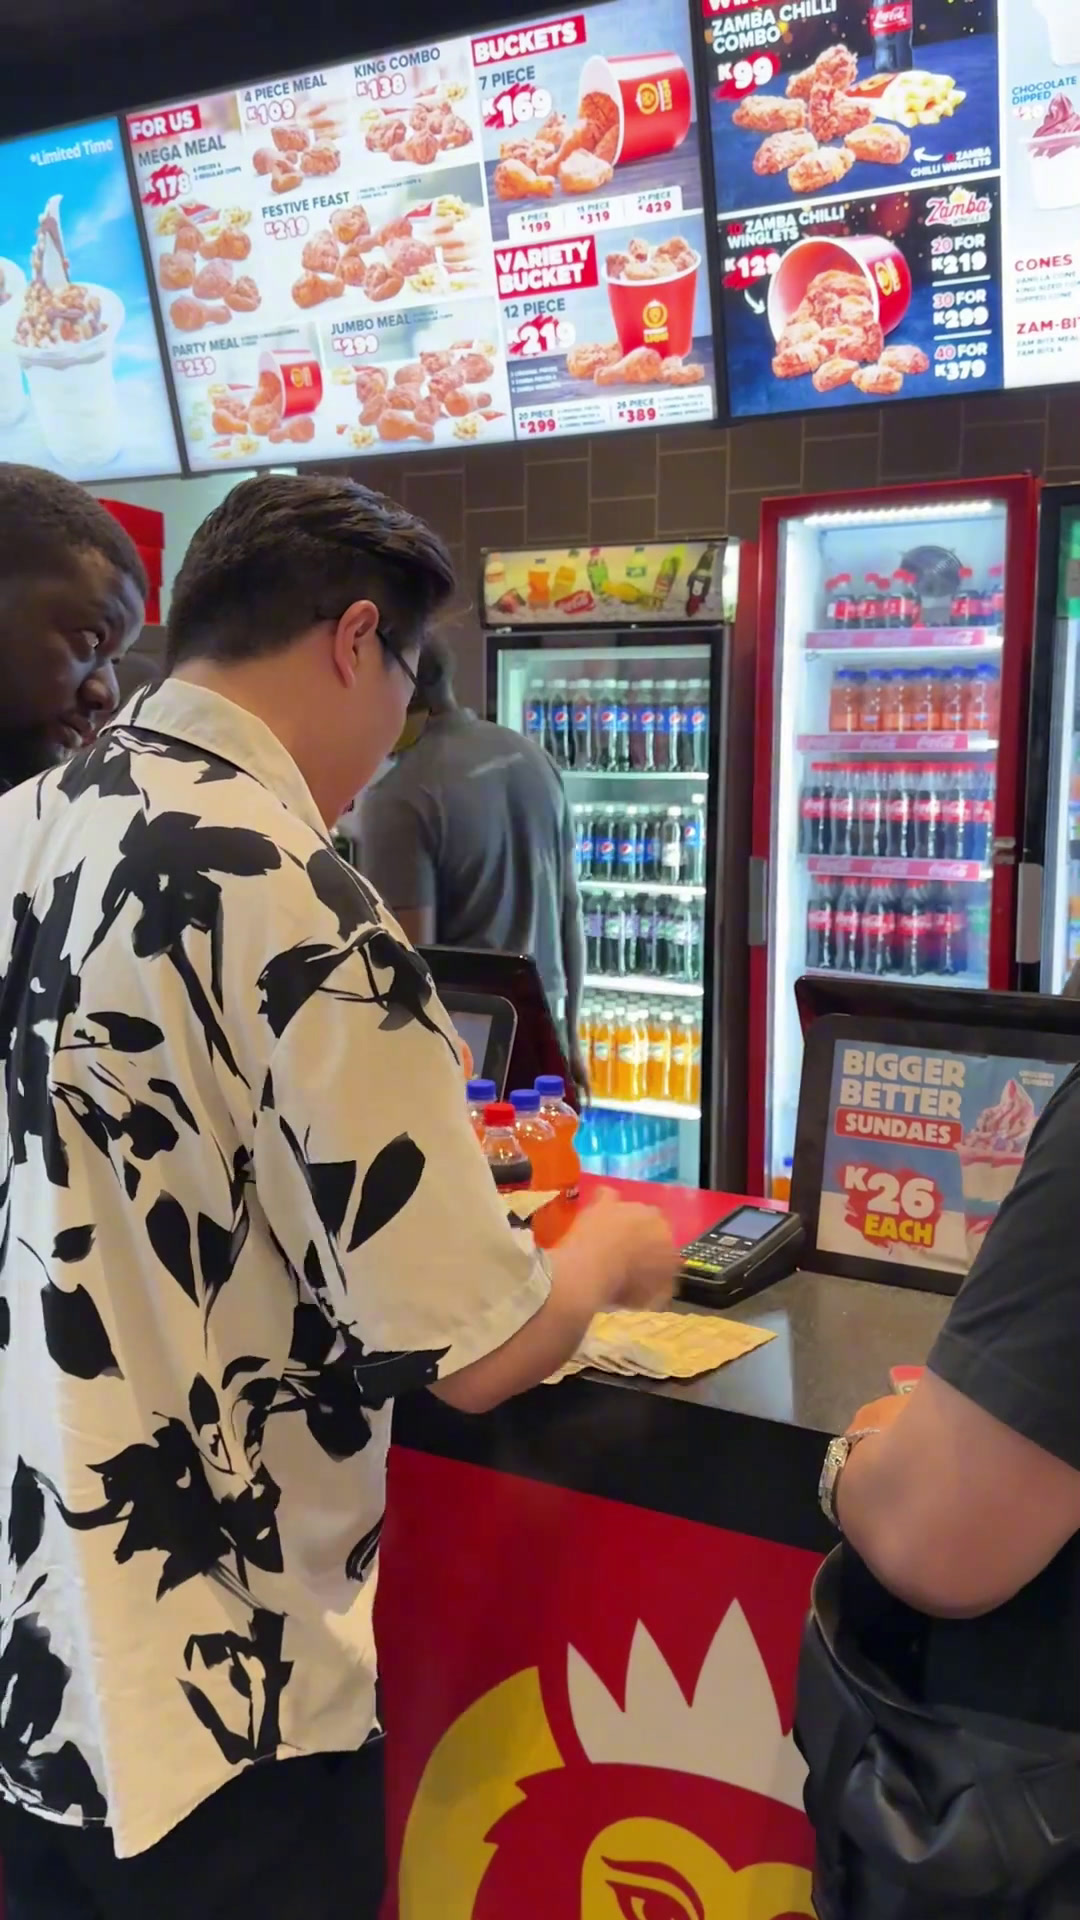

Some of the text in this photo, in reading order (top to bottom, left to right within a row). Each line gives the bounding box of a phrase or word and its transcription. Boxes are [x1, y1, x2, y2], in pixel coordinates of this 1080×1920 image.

[712, 9, 776, 37] ZAMBA
[780, 0, 836, 21] CHILLI
[474, 21, 577, 64] BUCKETS
[713, 25, 781, 54] COMBO
[354, 47, 440, 78] KING COMBO
[717, 57, 773, 89] K99
[244, 74, 327, 102] 4 PIECE MEAL
[356, 74, 406, 100] K138
[479, 65, 536, 90] 7 PIECE
[1012, 75, 1077, 96] CHOCOLATE
[481, 88, 552, 126] K169
[1012, 90, 1052, 105] DIPPED
[247, 99, 297, 125] K109
[130, 110, 195, 140] FOR US
[82, 139, 113, 155] Time
[139, 135, 226, 167] MEGA MEAL
[956, 146, 992, 160] ZAMBA
[911, 163, 941, 177] CHILLI
[262, 199, 310, 219] FESTIVE
[312, 191, 350, 210] FEAST
[588, 201, 610, 211] PIECE
[648, 190, 671, 200] PIECE
[528, 212, 549, 221] PIECE
[927, 191, 988, 224] Zamba
[264, 216, 308, 240] K219
[745, 214, 797, 234] ZAMBA
[799, 206, 845, 225] CHILLI
[727, 227, 799, 249] WINGLETS
[931, 234, 985, 254] 20 FOR
[495, 239, 590, 274] VARIETY
[931, 252, 987, 275] K219
[1015, 254, 1073, 272] CONES
[499, 263, 585, 294] BUCKET
[504, 298, 566, 318] 12 PIECE
[932, 289, 986, 309] 30 FOR
[331, 319, 374, 335] JUMBO
[377, 313, 412, 329] MEAL
[932, 306, 989, 329] K299
[172, 336, 240, 357] PARTY MEAL
[332, 335, 379, 356] K299
[507, 321, 576, 354] K219
[934, 342, 987, 361] 40 FOR
[176, 357, 216, 378] K259
[934, 359, 986, 380] K379
[530, 409, 554, 419] PIECE
[618, 407, 656, 423] K389
[629, 398, 654, 409] PIECE
[520, 419, 556, 434] K299
[843, 1049, 965, 1088] BIGGER
[840, 1078, 962, 1119] BETTER
[845, 1113, 951, 1144] SUNDAES
[844, 1165, 935, 1219] K26
[865, 1214, 934, 1246] EACH
